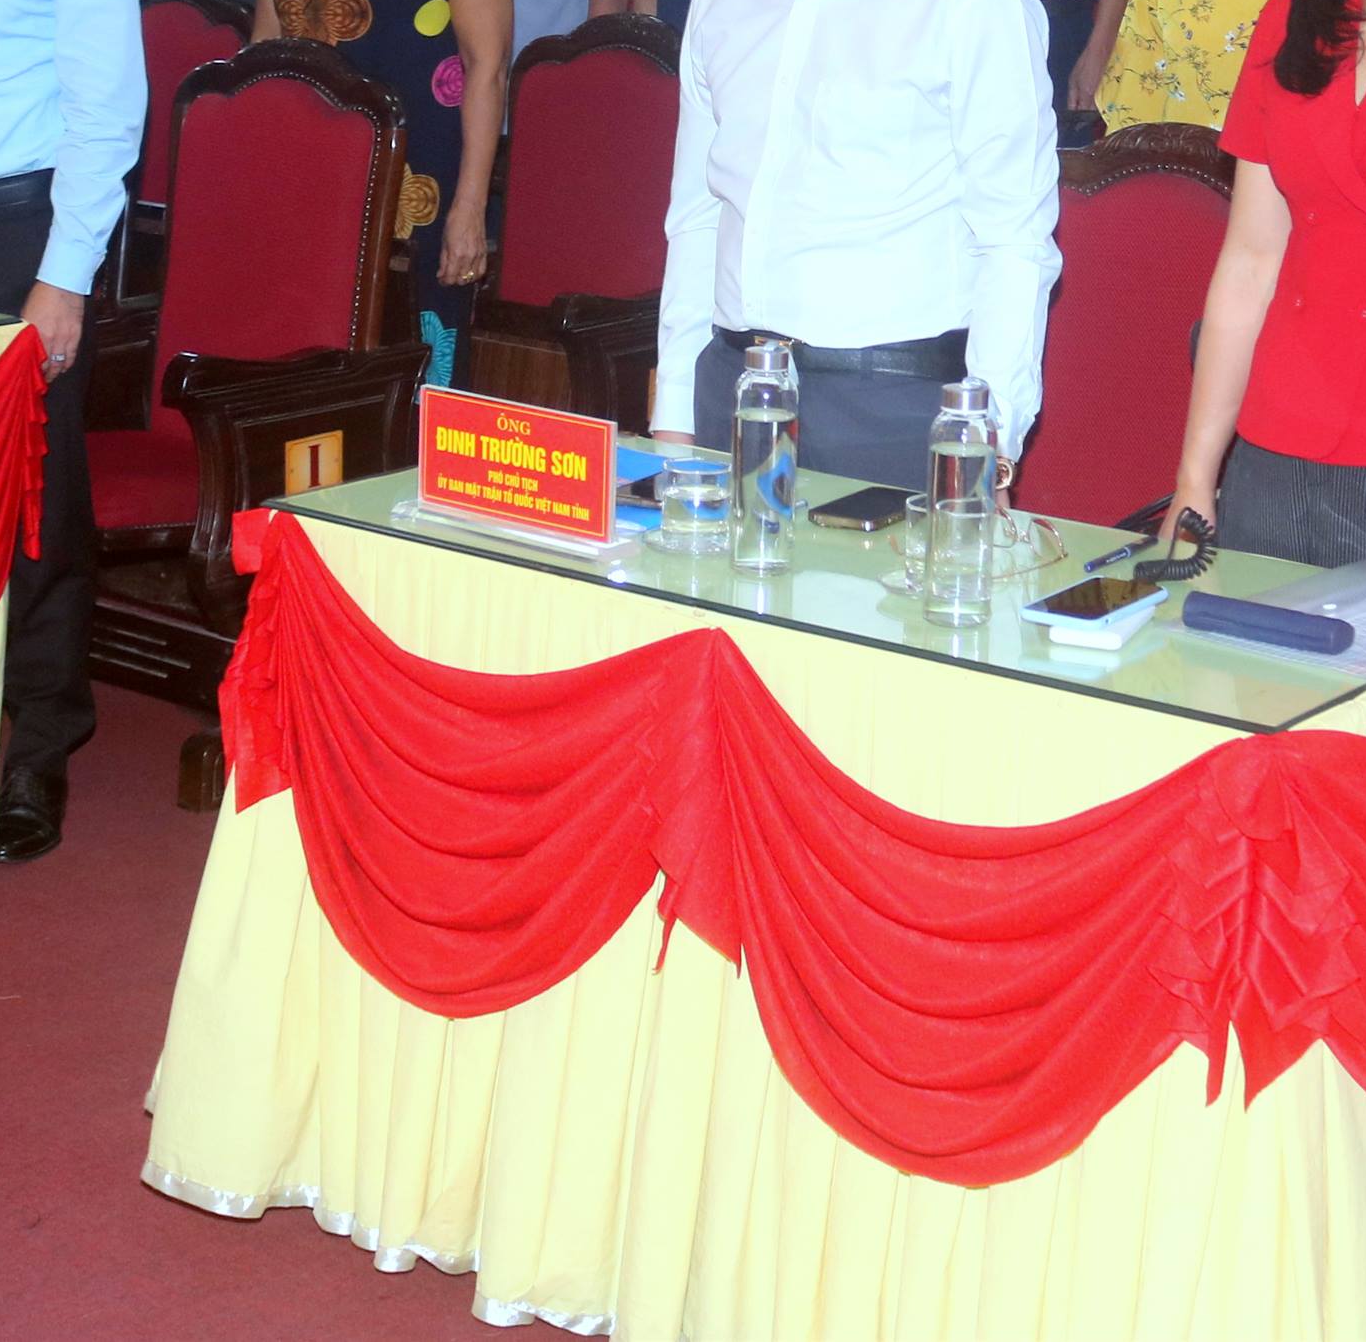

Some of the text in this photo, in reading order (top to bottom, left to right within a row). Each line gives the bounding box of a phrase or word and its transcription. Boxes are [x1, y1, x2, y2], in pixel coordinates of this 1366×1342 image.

[496, 412, 531, 435] ÔNG
[436, 426, 587, 482] ĐINH TRƯỜNG SƠN
